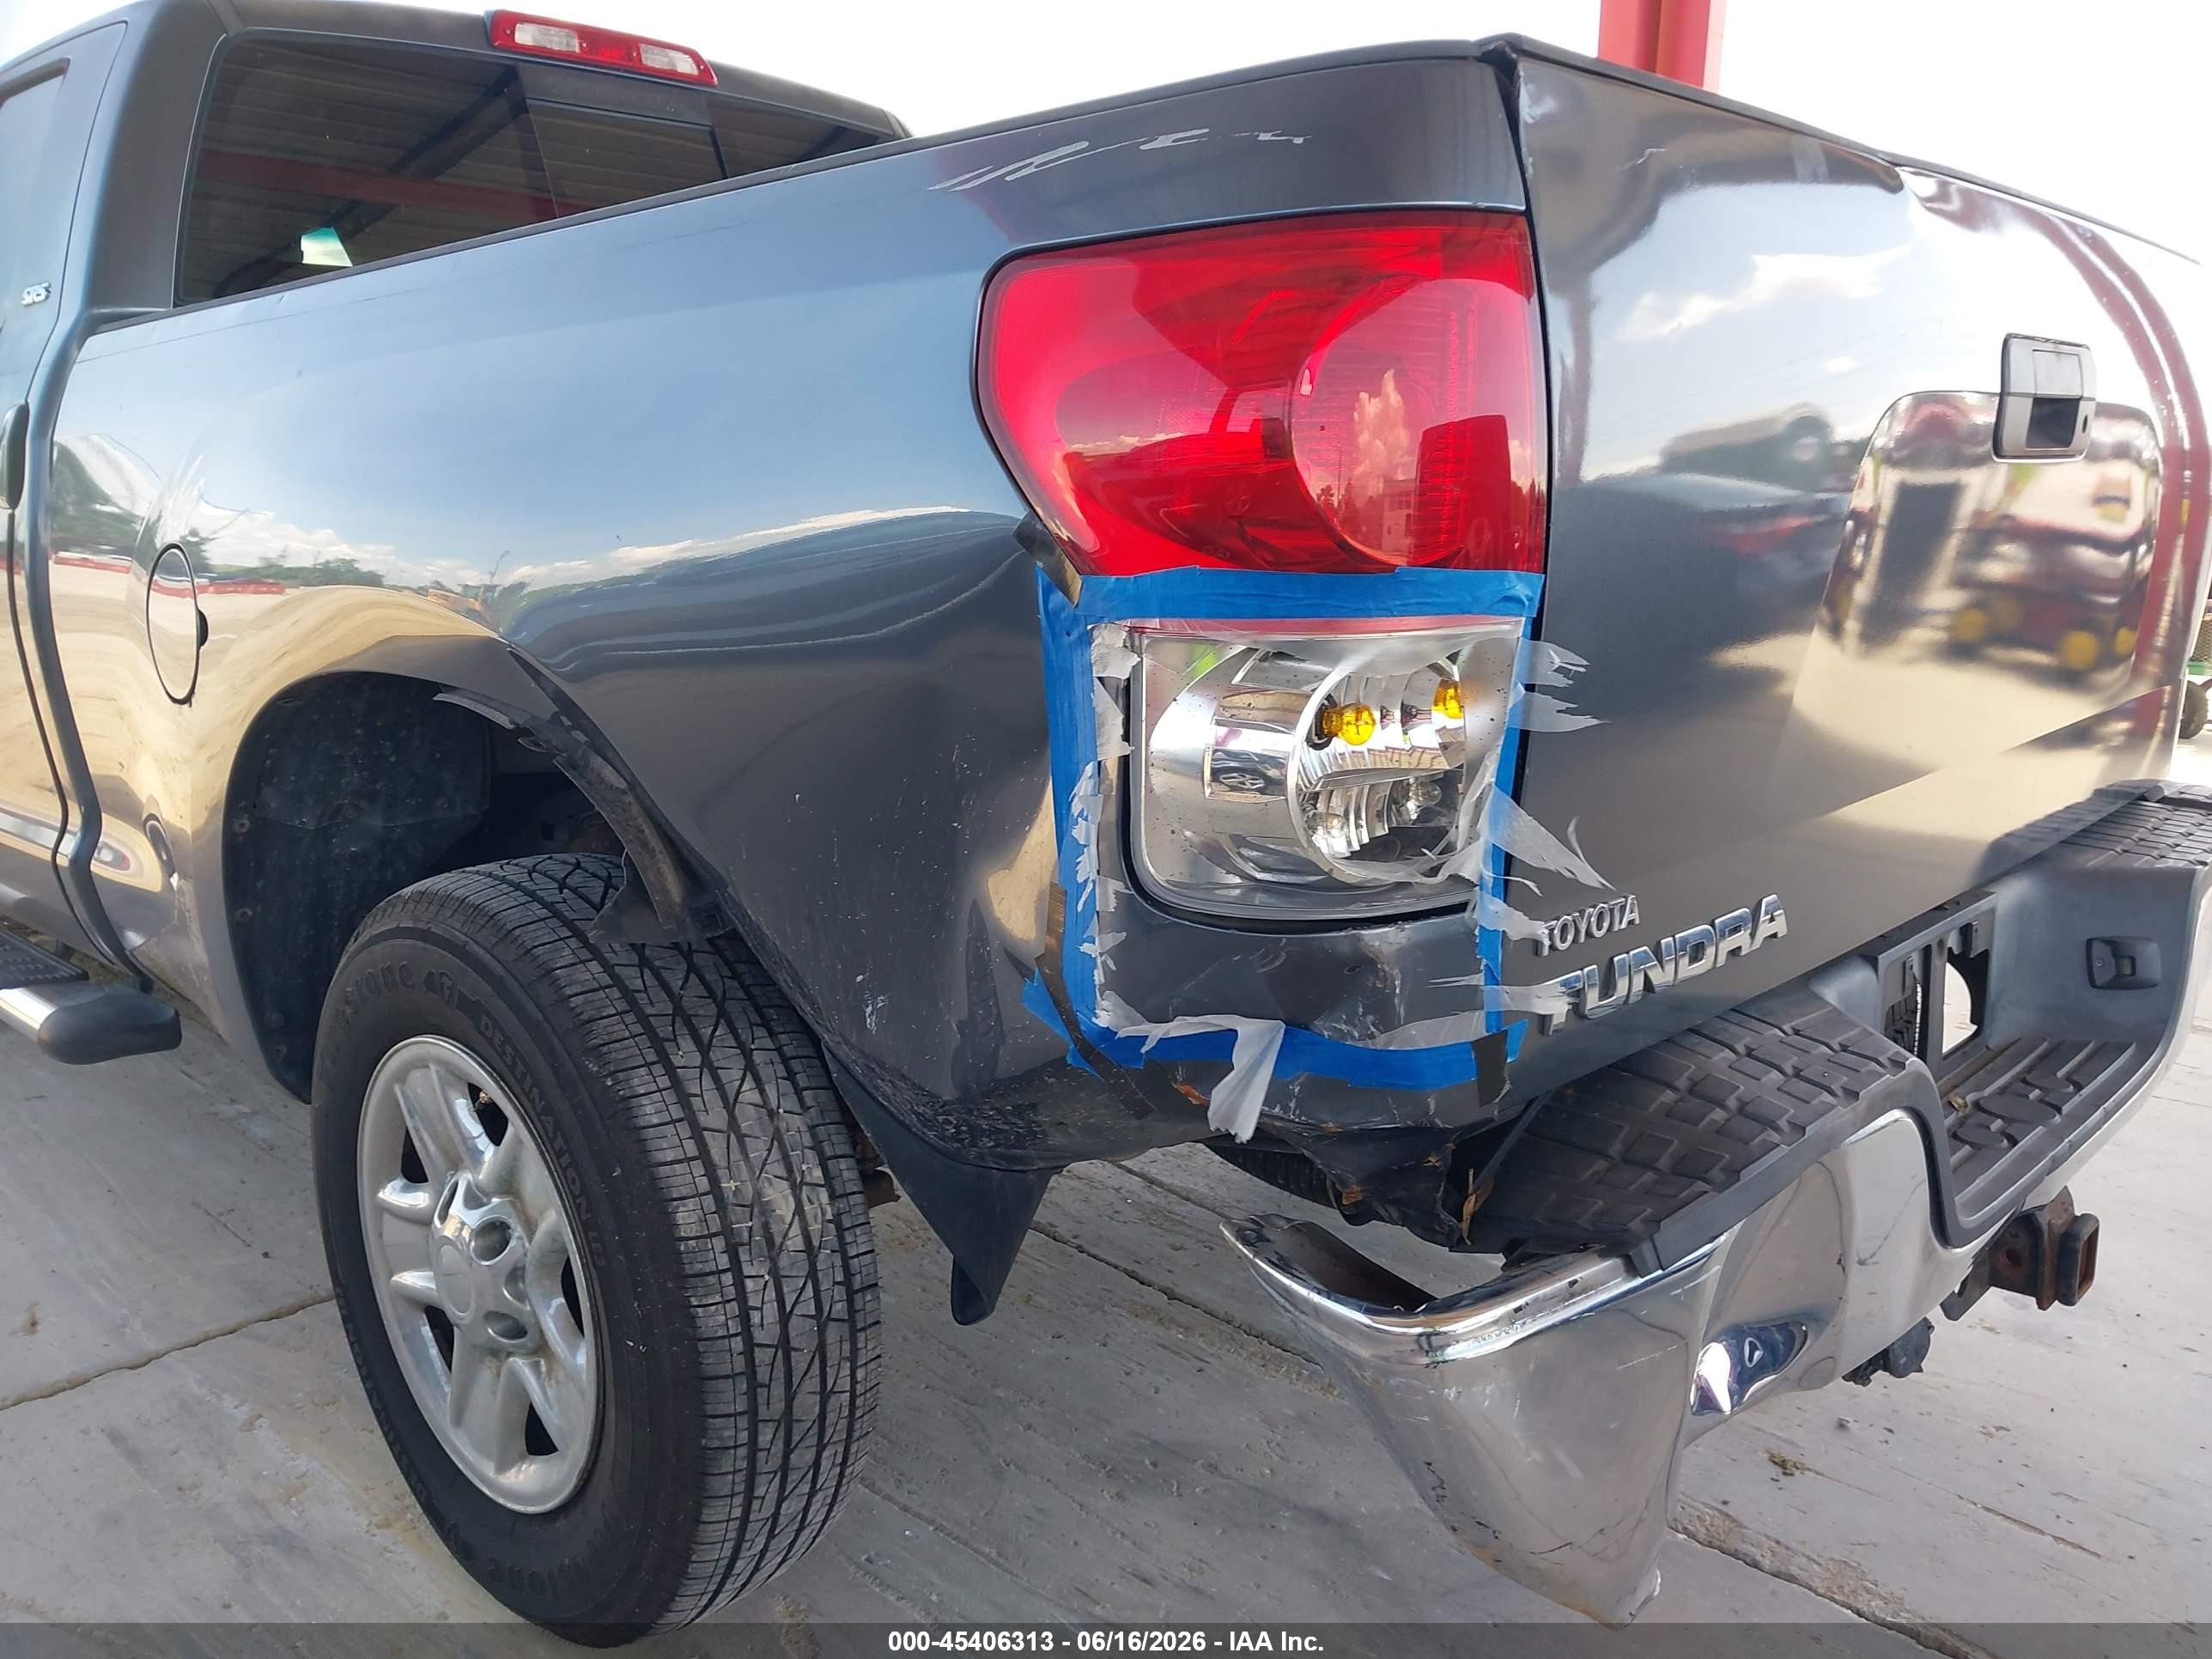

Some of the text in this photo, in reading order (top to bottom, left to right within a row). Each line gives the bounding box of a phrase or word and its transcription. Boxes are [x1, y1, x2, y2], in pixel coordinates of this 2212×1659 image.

[1537, 893, 1641, 957] TOYOTA
[1540, 893, 1788, 1036] TUNDRA
[479, 1012, 592, 1223] DESTINATION
